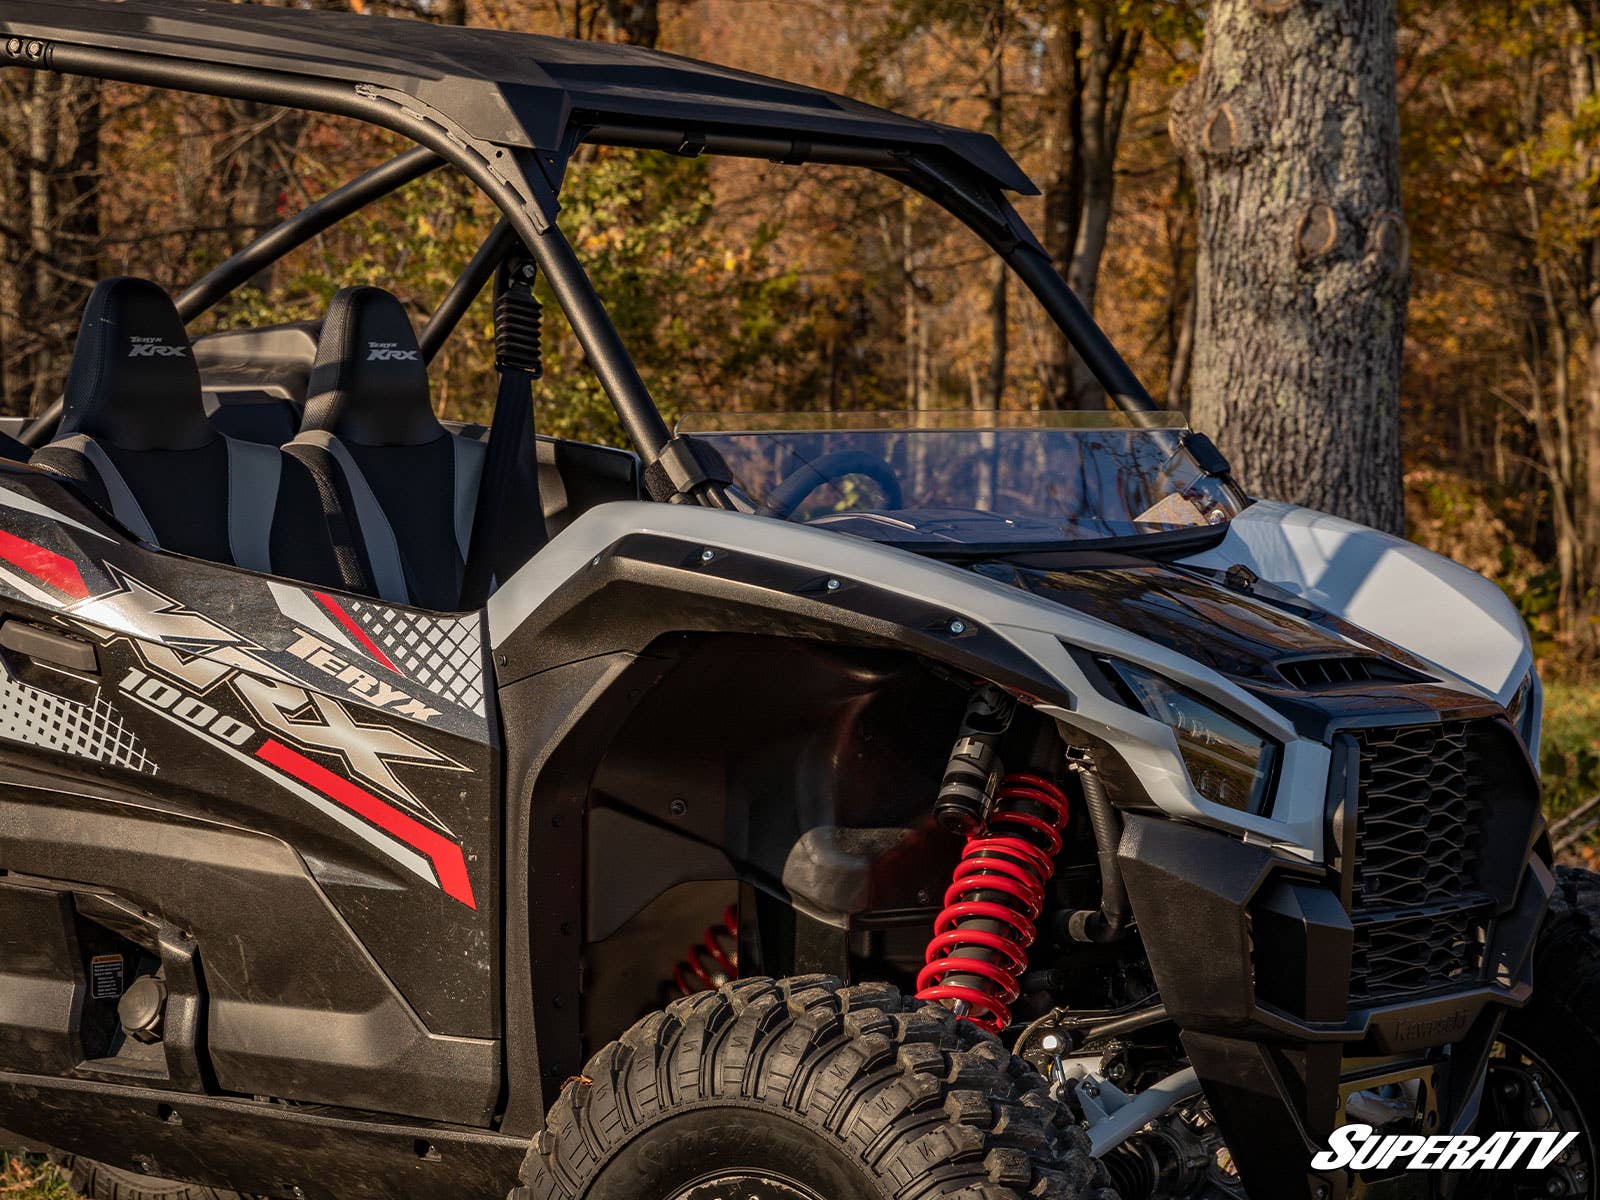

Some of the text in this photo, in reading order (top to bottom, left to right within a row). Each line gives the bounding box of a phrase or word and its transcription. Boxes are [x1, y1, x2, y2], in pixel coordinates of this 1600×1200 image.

[128, 344, 187, 357] KRX
[366, 349, 419, 361] KRX
[118, 666, 256, 746] 1000
